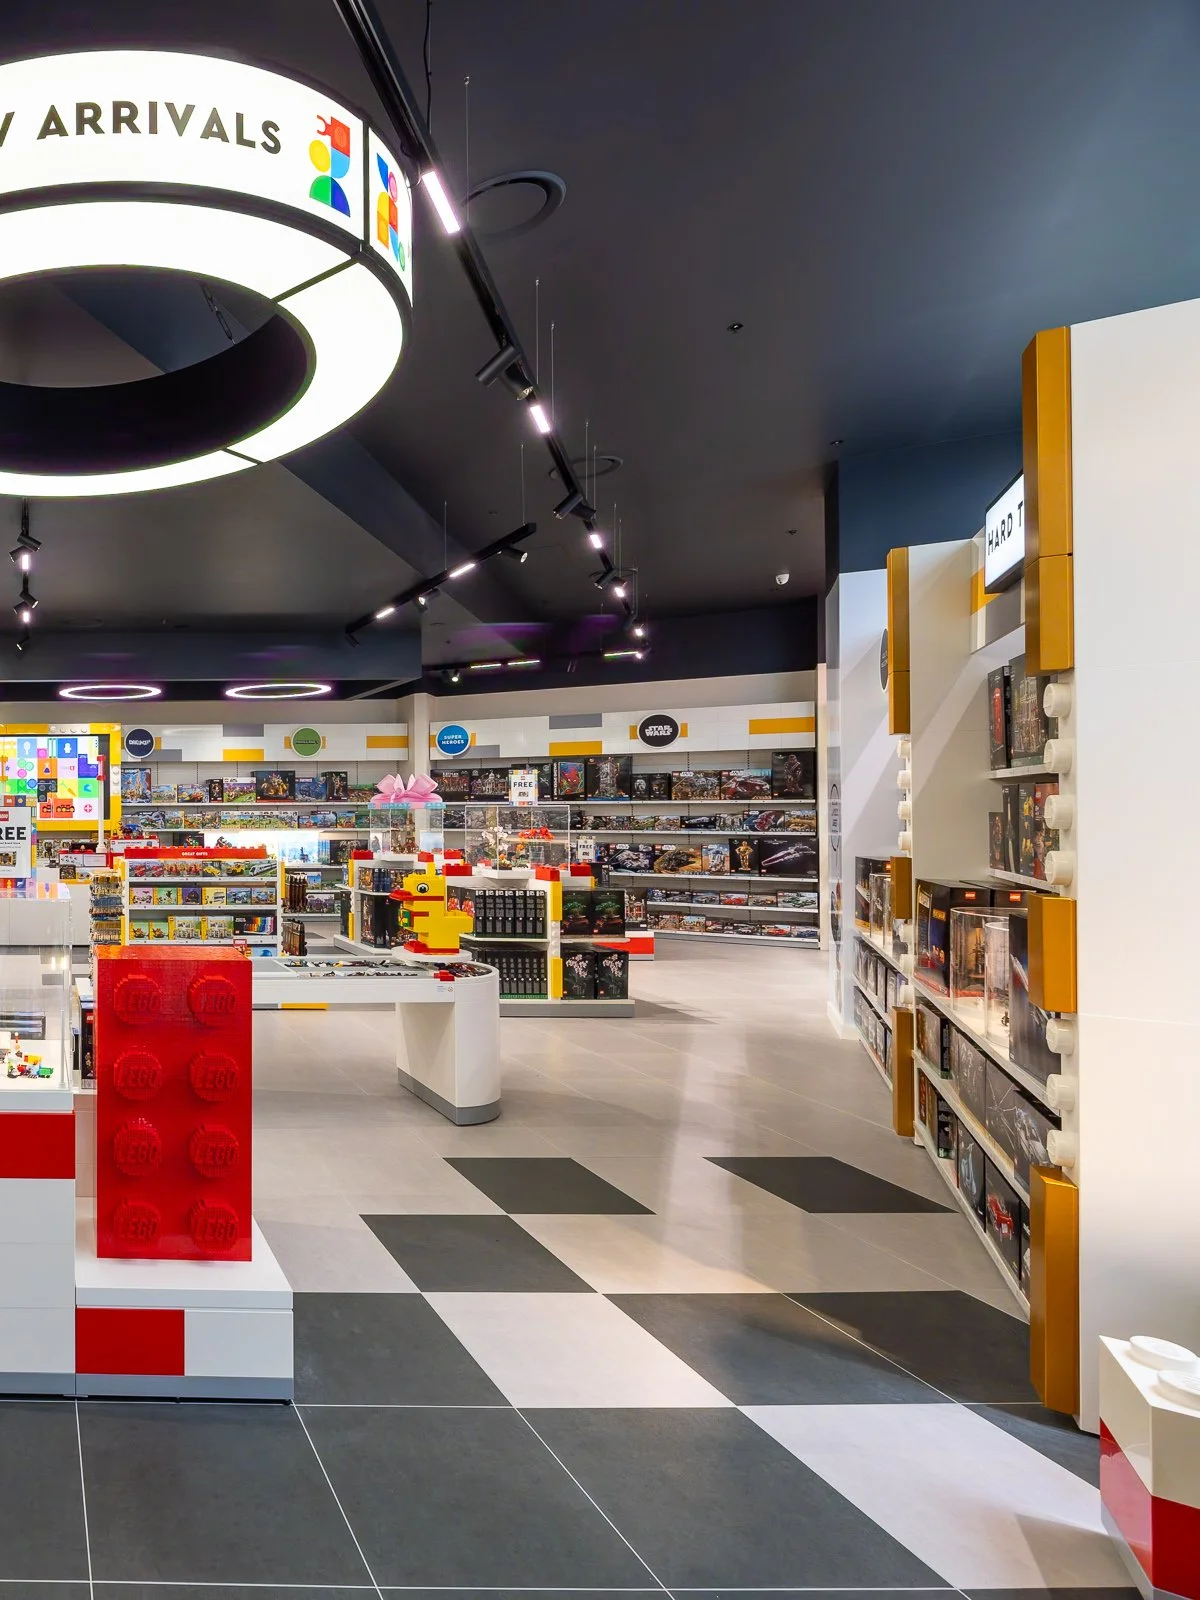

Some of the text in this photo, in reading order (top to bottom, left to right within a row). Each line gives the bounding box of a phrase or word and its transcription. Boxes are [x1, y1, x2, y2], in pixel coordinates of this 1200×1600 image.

[37, 100, 282, 155] ARRIVALS
[987, 512, 1013, 557] HARD
[644, 728, 673, 737] WARS
